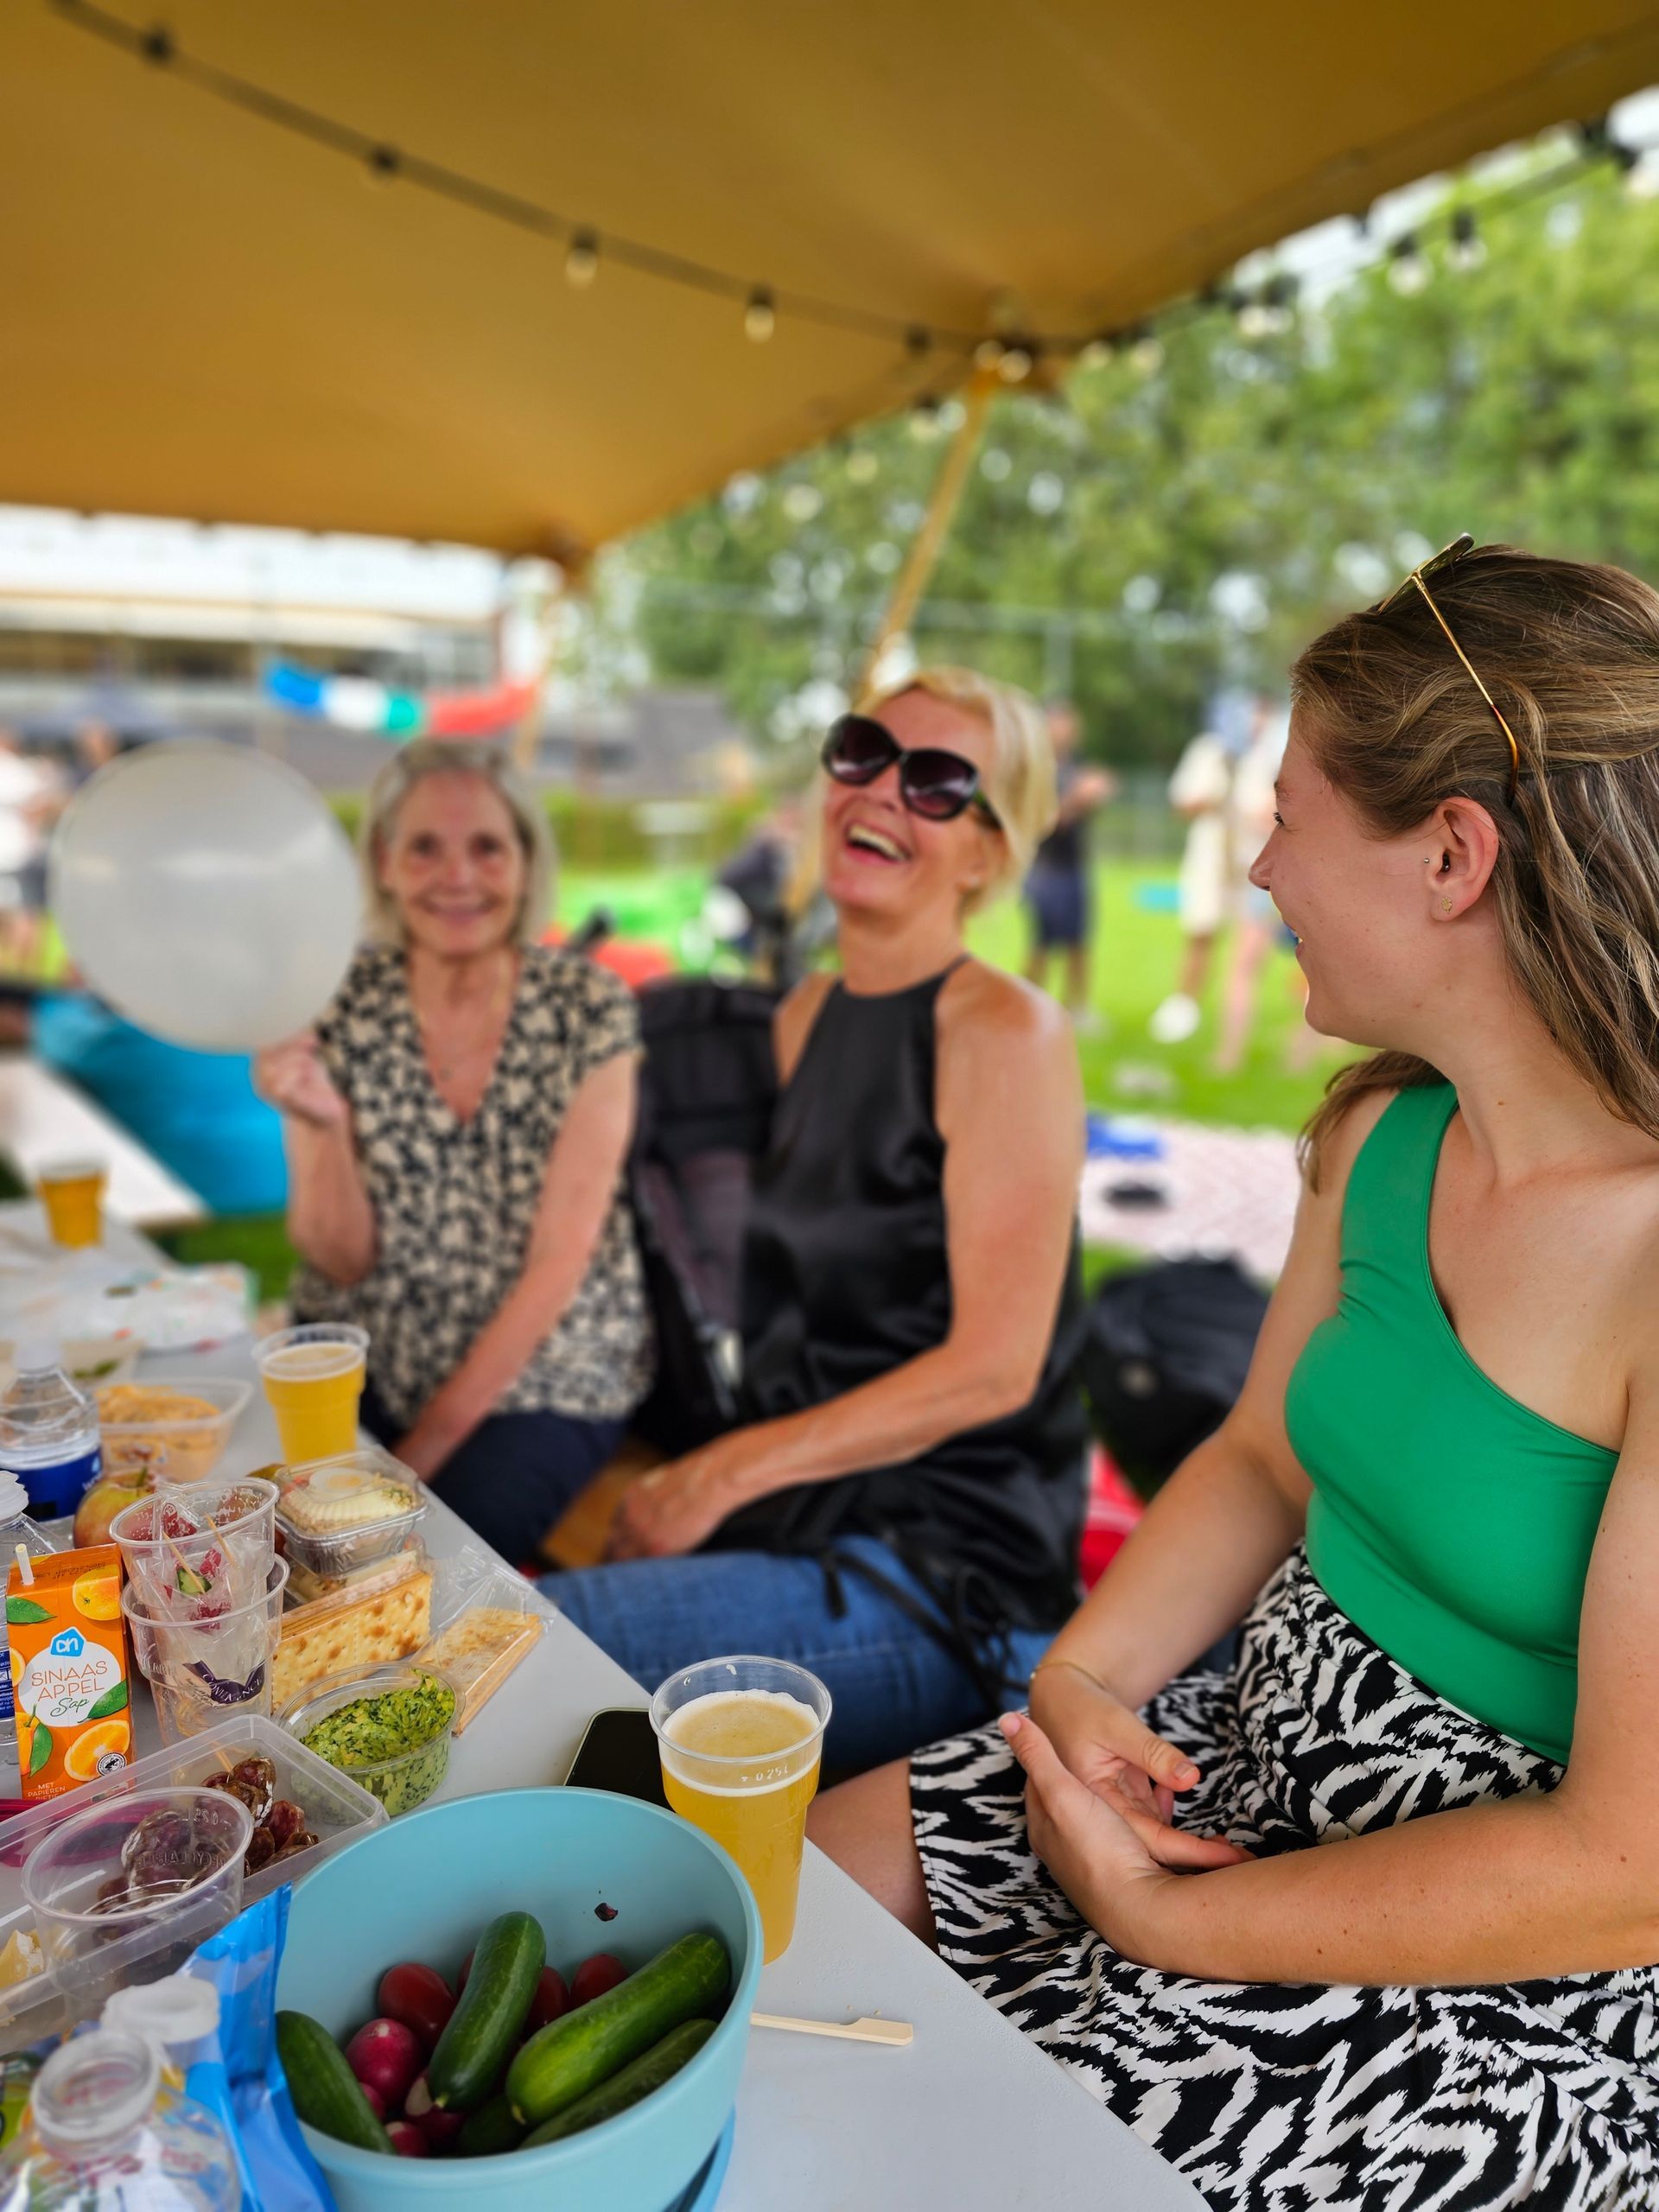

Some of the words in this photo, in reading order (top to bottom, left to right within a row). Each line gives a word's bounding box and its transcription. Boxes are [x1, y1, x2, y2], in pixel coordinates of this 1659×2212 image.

[31, 1660, 108, 1687] SINAAS
[37, 1678, 105, 1701] APPEL
[50, 1697, 90, 1717] Sap
[28, 1786, 66, 1797] PAPIEREN
